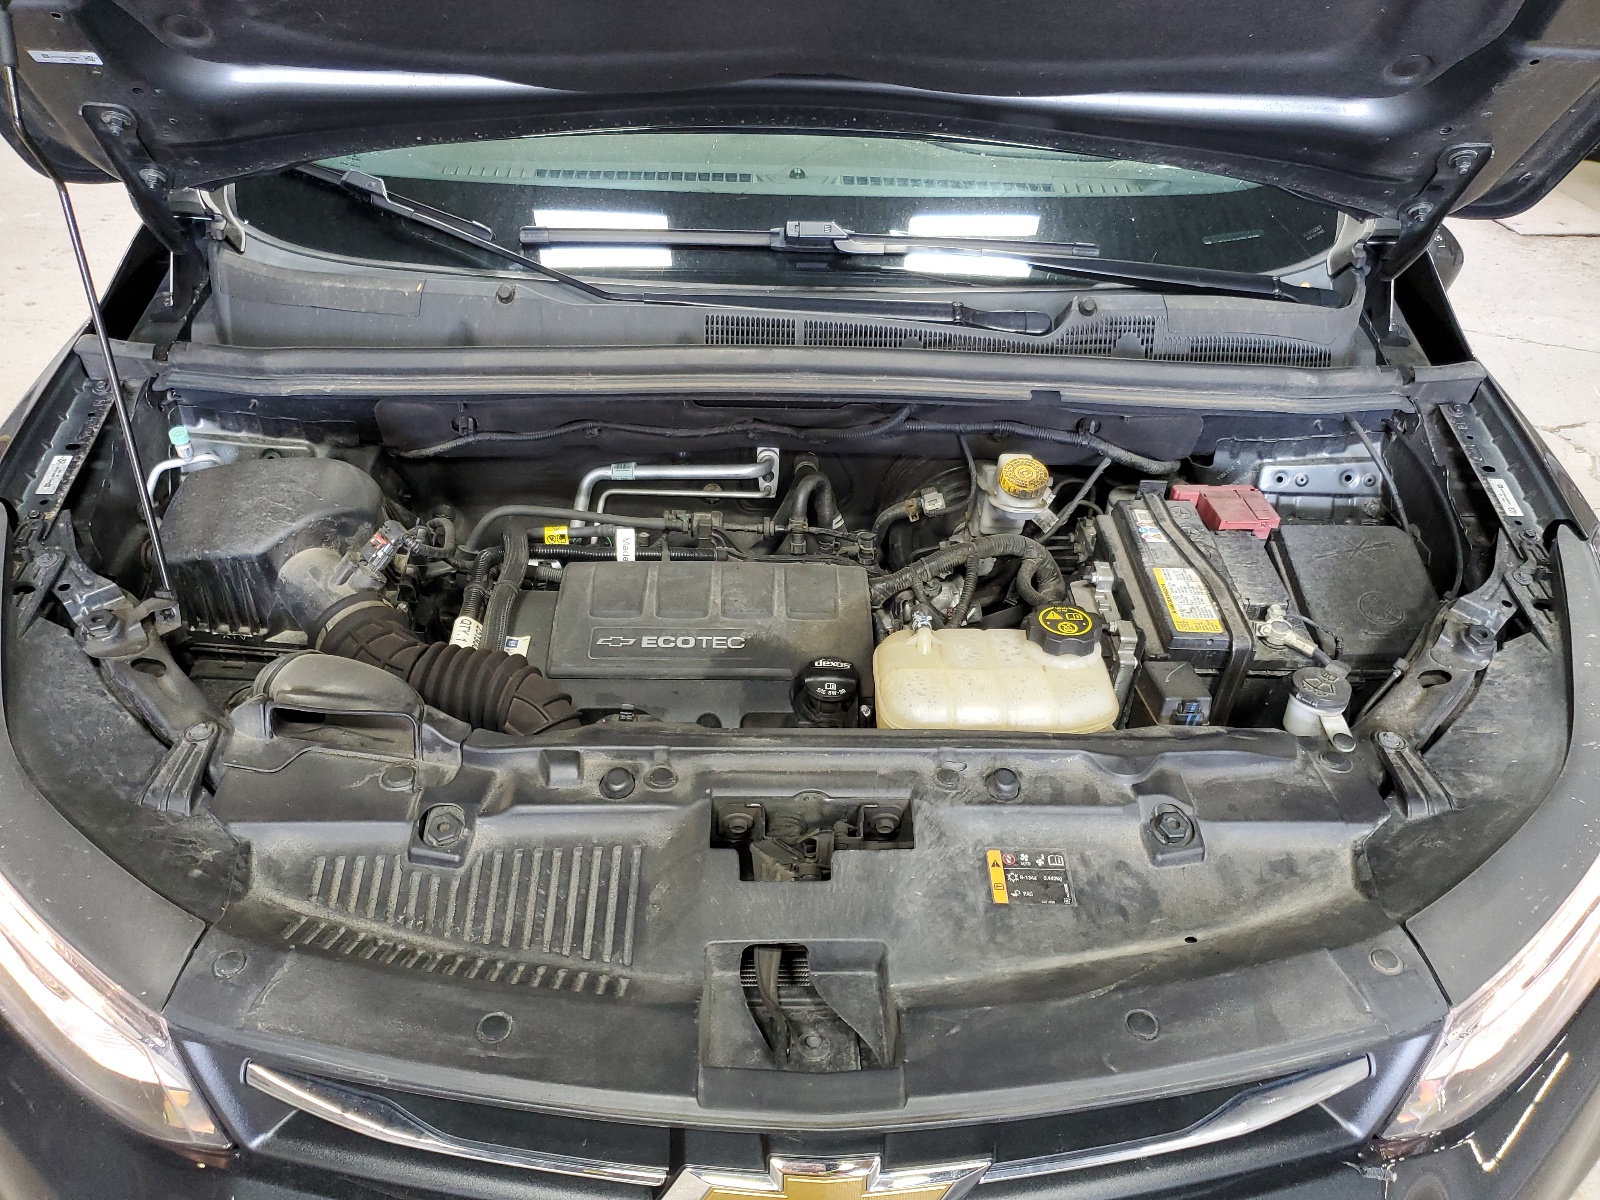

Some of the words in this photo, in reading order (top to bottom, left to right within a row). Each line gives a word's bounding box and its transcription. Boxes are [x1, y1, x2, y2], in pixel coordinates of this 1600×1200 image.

[622, 537, 631, 562] Made
[641, 636, 746, 649] ECOTEC
[814, 658, 853, 669] dexos
